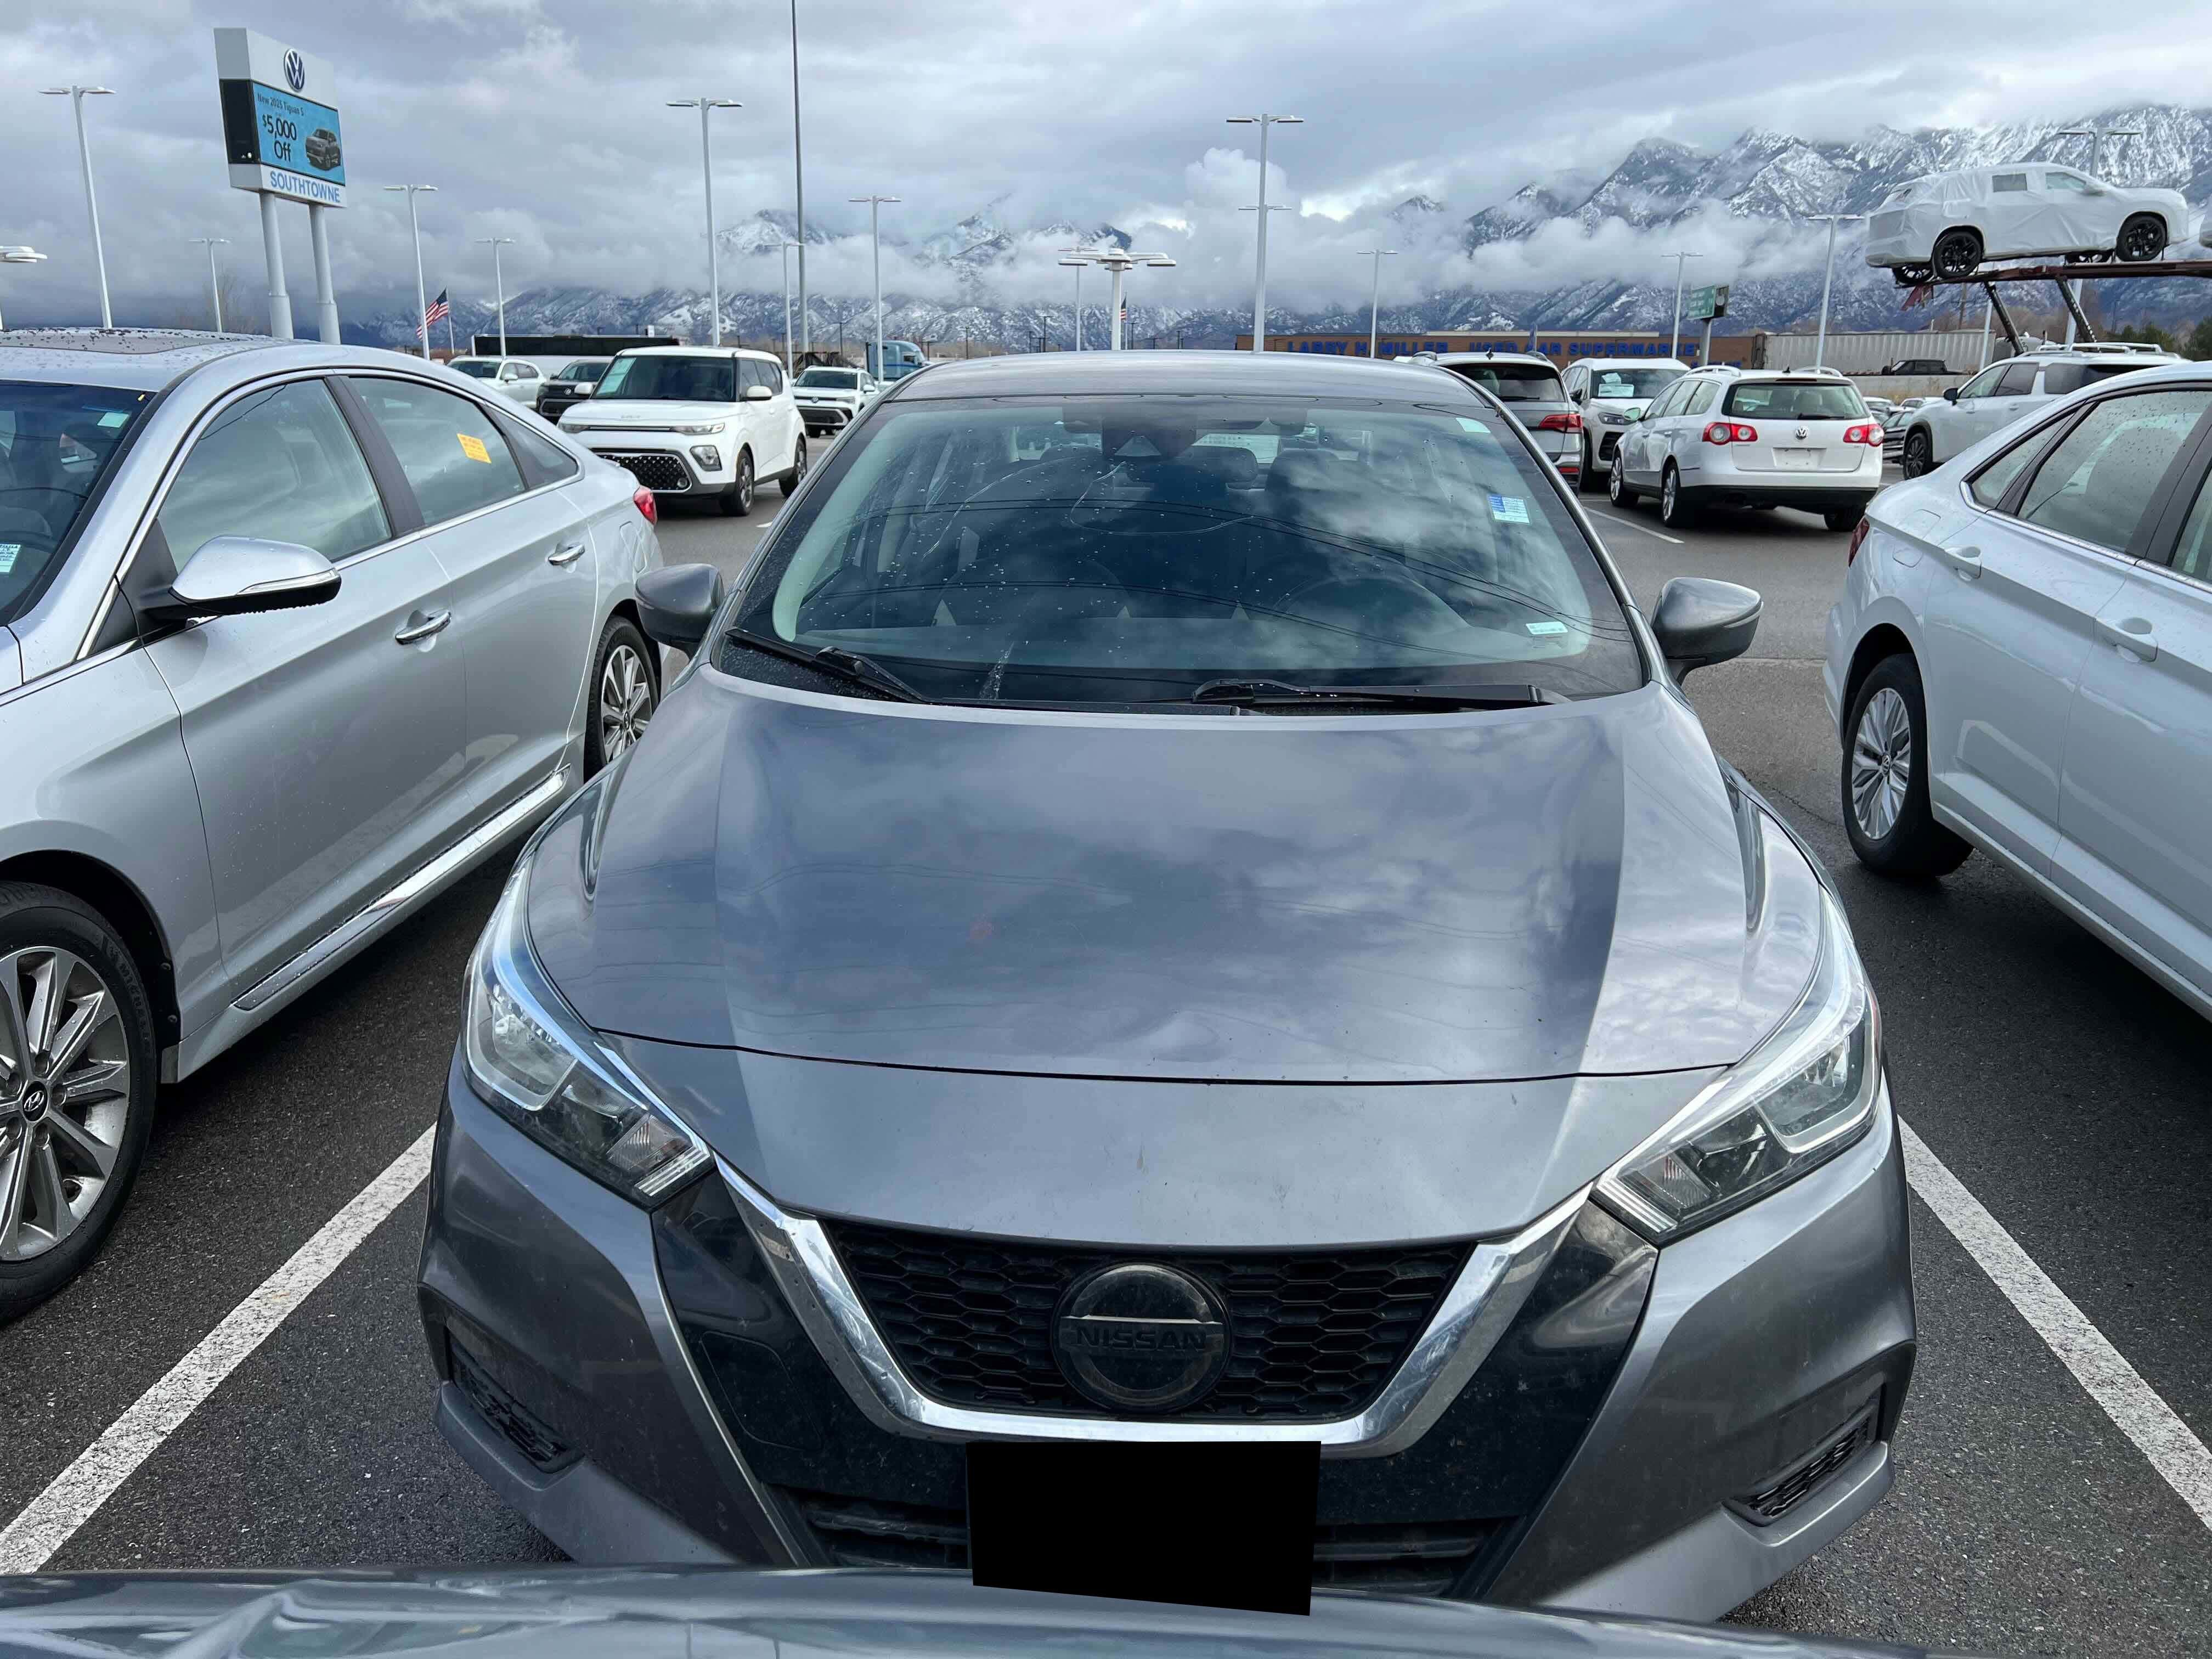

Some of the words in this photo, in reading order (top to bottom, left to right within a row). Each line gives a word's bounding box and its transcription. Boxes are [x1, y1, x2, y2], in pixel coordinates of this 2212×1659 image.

[257, 93, 269, 104] New
[270, 98, 283, 109] 2025
[263, 114, 297, 141] $5,000
[274, 141, 291, 162] Off
[270, 171, 341, 203] SOUTHTOWNE
[1287, 341, 1348, 356] LARRY
[1378, 342, 1448, 356] MILLER
[1075, 1328, 1209, 1352] NISSAN
